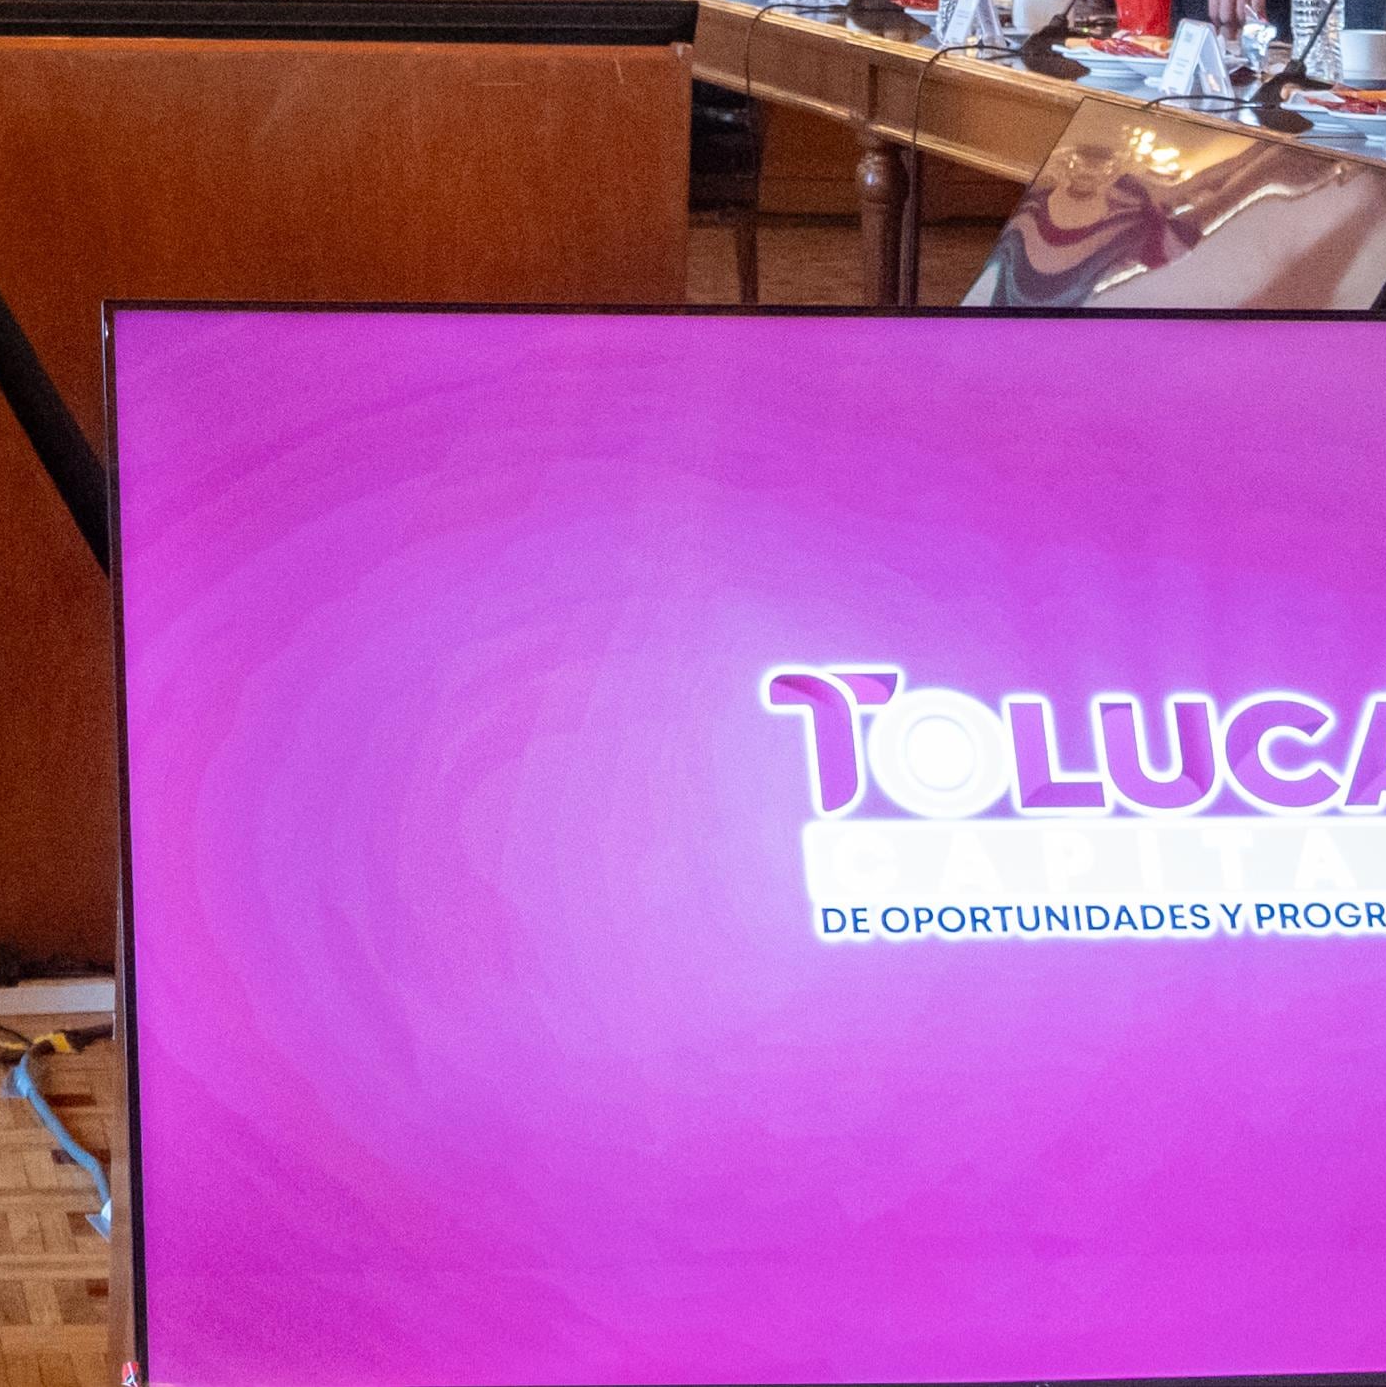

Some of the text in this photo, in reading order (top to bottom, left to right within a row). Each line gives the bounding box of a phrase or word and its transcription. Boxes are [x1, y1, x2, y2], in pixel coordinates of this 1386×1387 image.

[821, 907, 870, 933] DE
[880, 903, 1211, 933] OPORTUNIDADES
[1219, 903, 1243, 930] Y
